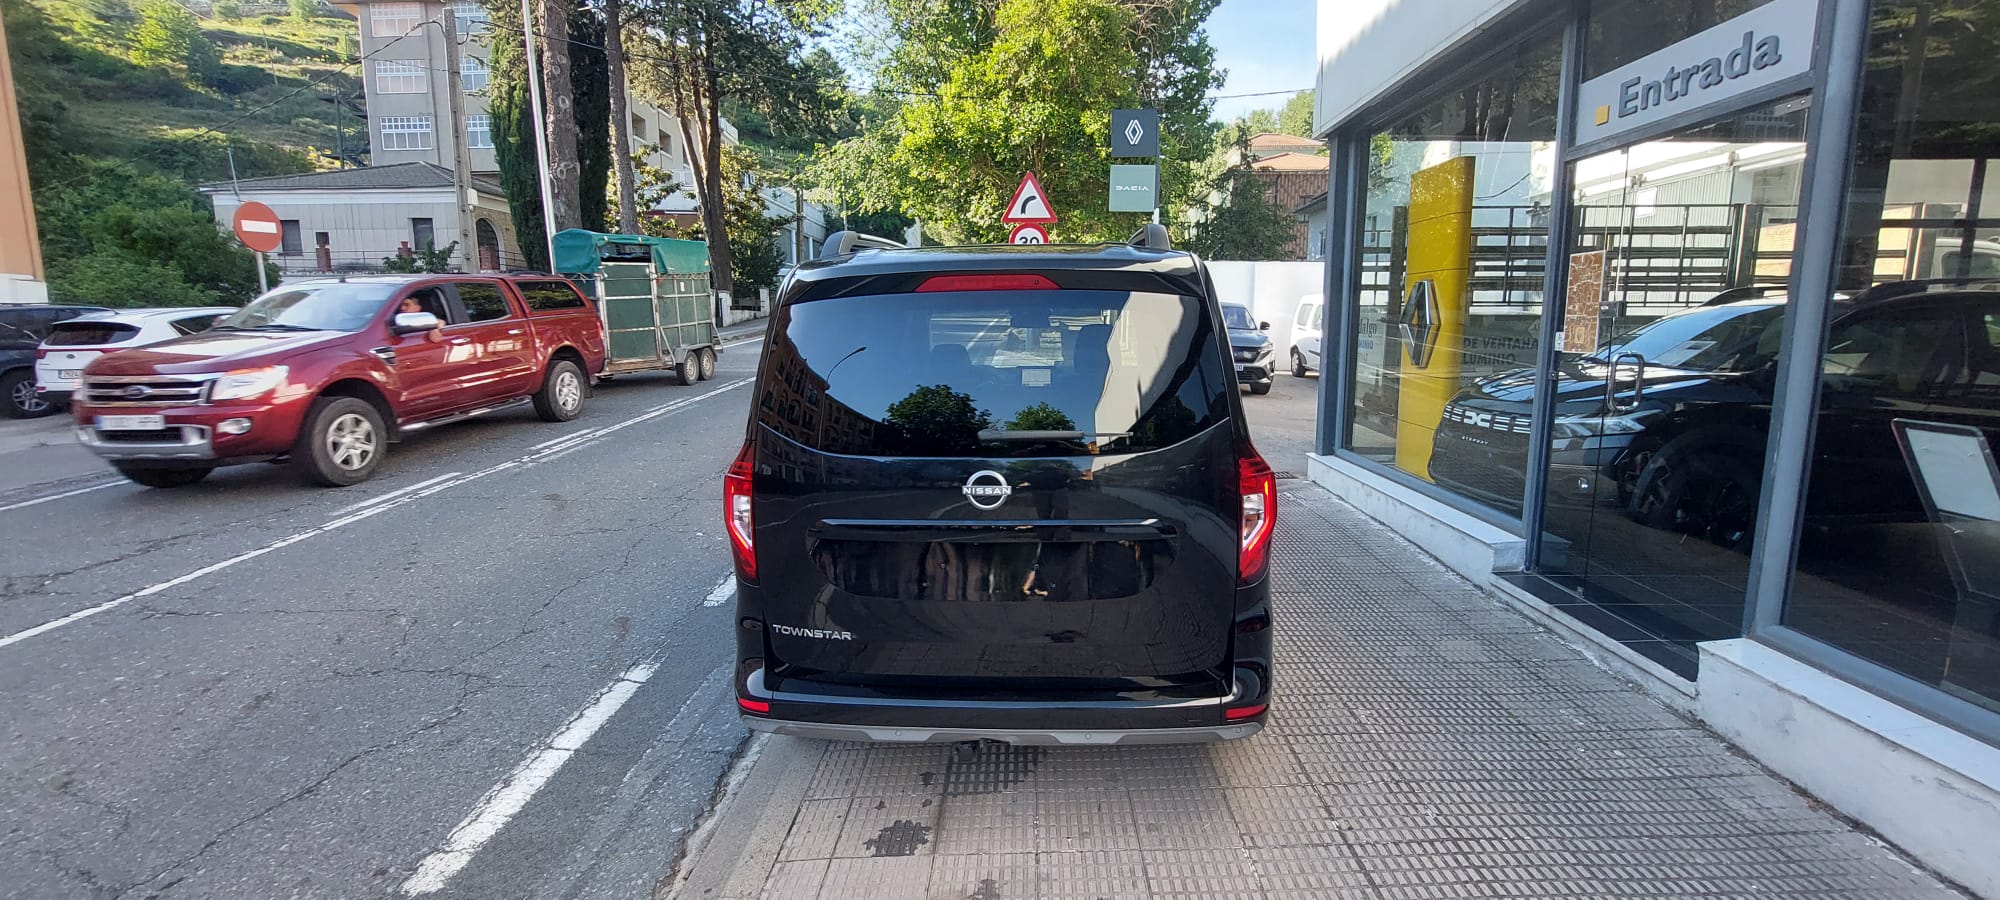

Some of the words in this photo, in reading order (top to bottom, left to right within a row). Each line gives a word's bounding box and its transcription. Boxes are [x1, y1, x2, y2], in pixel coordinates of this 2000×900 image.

[1617, 30, 1782, 118] Entrada
[1461, 435, 1489, 445] STEPWAY
[962, 486, 1012, 496] NISSAN
[772, 624, 852, 641] TOWNSTAR
